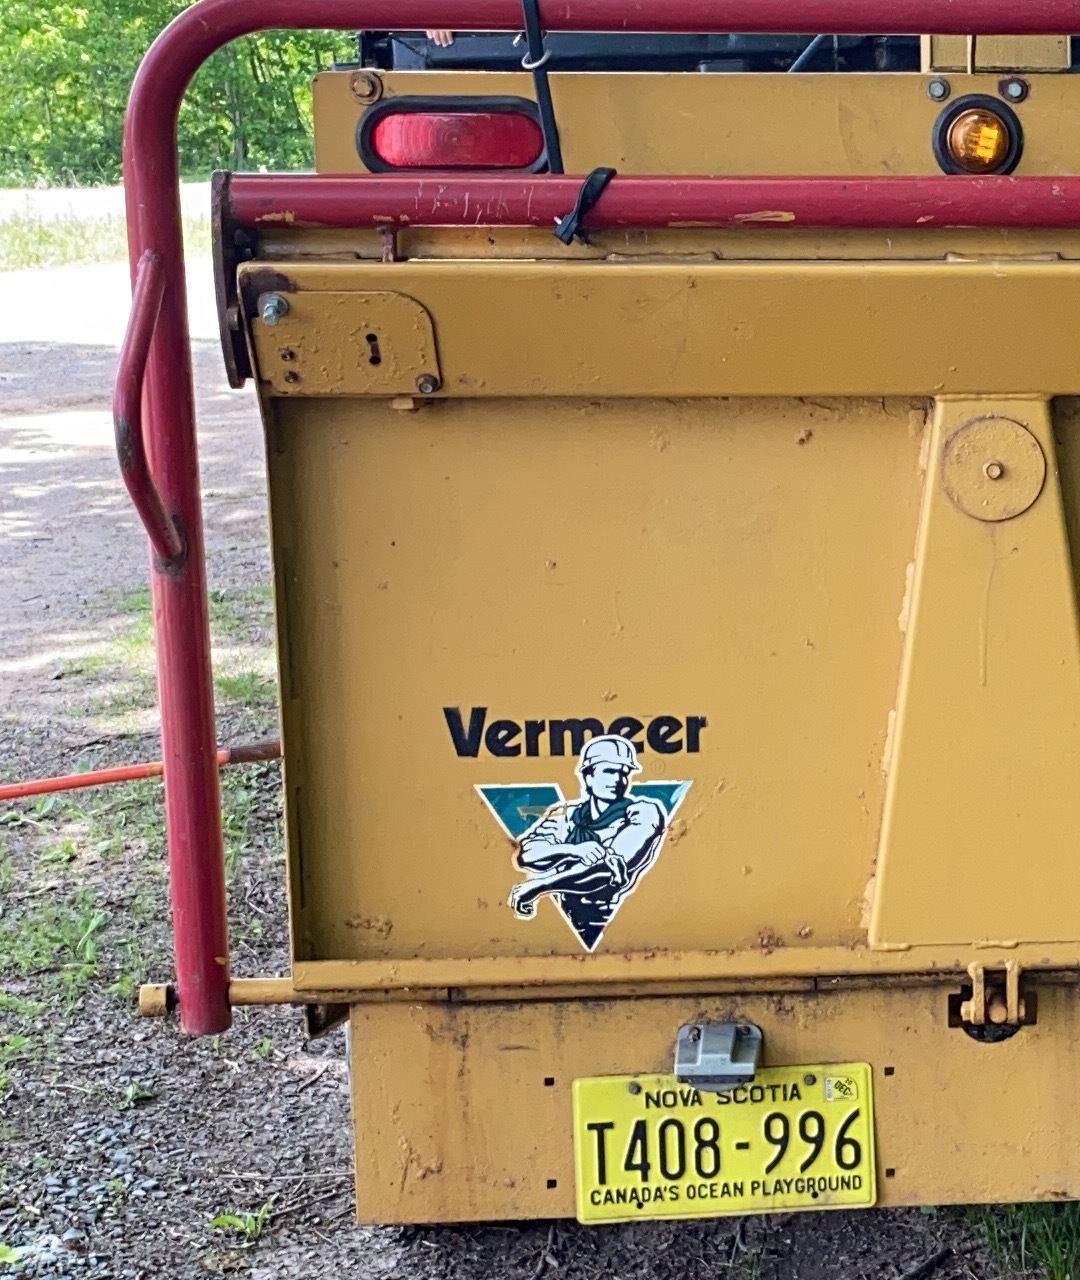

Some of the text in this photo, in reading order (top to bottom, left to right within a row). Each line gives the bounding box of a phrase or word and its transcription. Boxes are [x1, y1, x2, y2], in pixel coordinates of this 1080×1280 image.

[443, 706, 707, 758] Vermeer
[645, 1089, 702, 1109] NOVA
[716, 1083, 802, 1105] SCOTIA
[833, 1079, 851, 1096] DEC
[586, 1107, 862, 1185] T408-996
[590, 1174, 862, 1206] CANADA'S OCEAN PLAYGROUND
